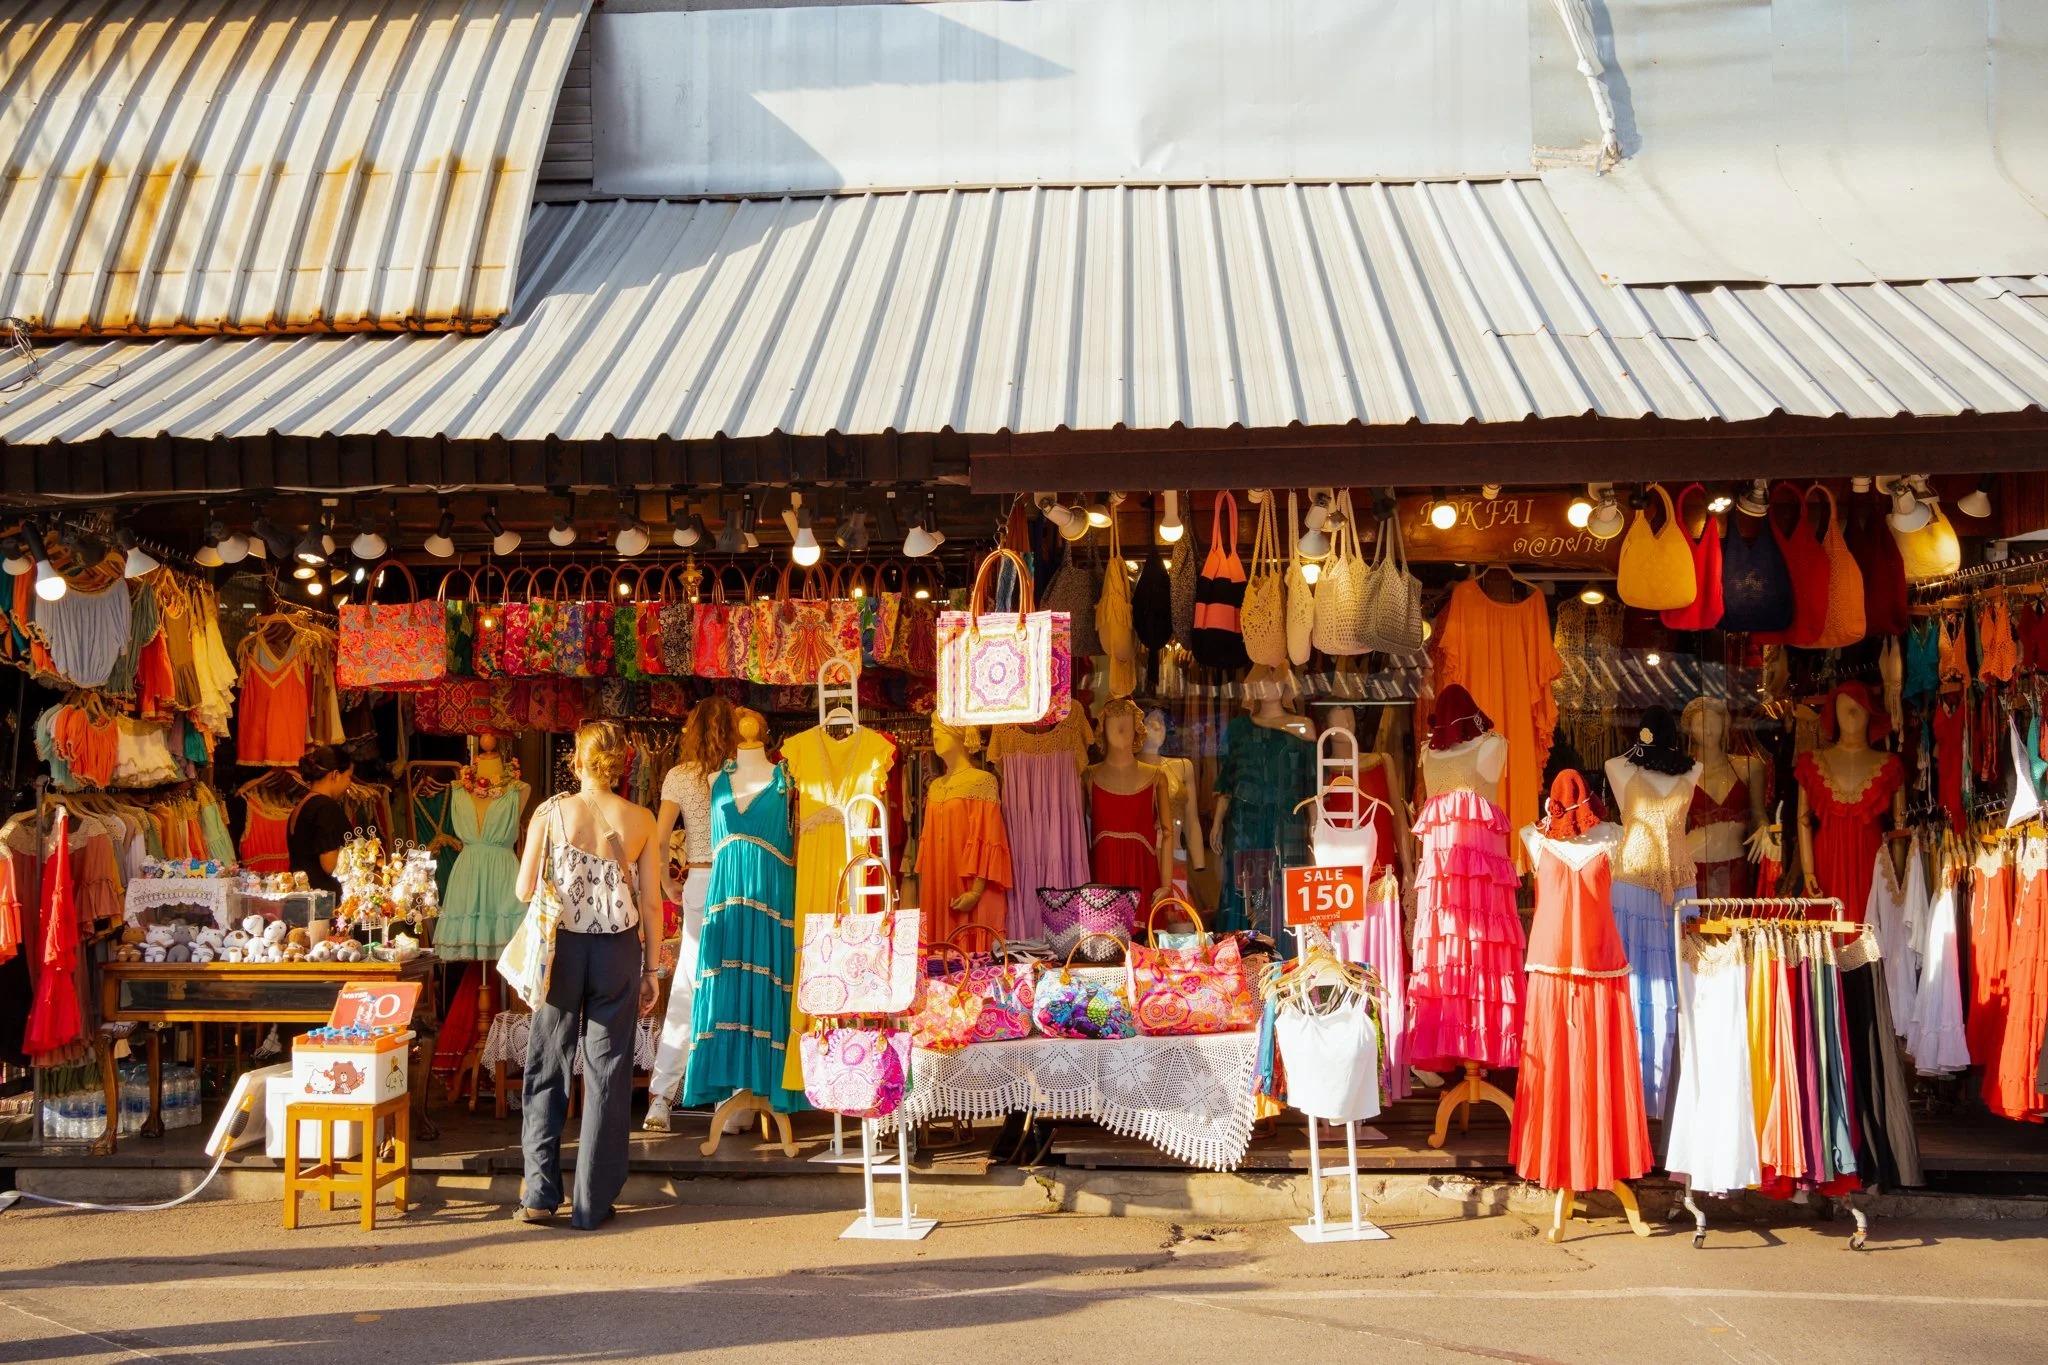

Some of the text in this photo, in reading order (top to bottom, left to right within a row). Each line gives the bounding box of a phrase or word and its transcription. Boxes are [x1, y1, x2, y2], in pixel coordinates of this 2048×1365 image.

[1420, 499, 1534, 531] KFAI
[1303, 869, 1344, 883] SALE
[1297, 883, 1355, 912] 150
